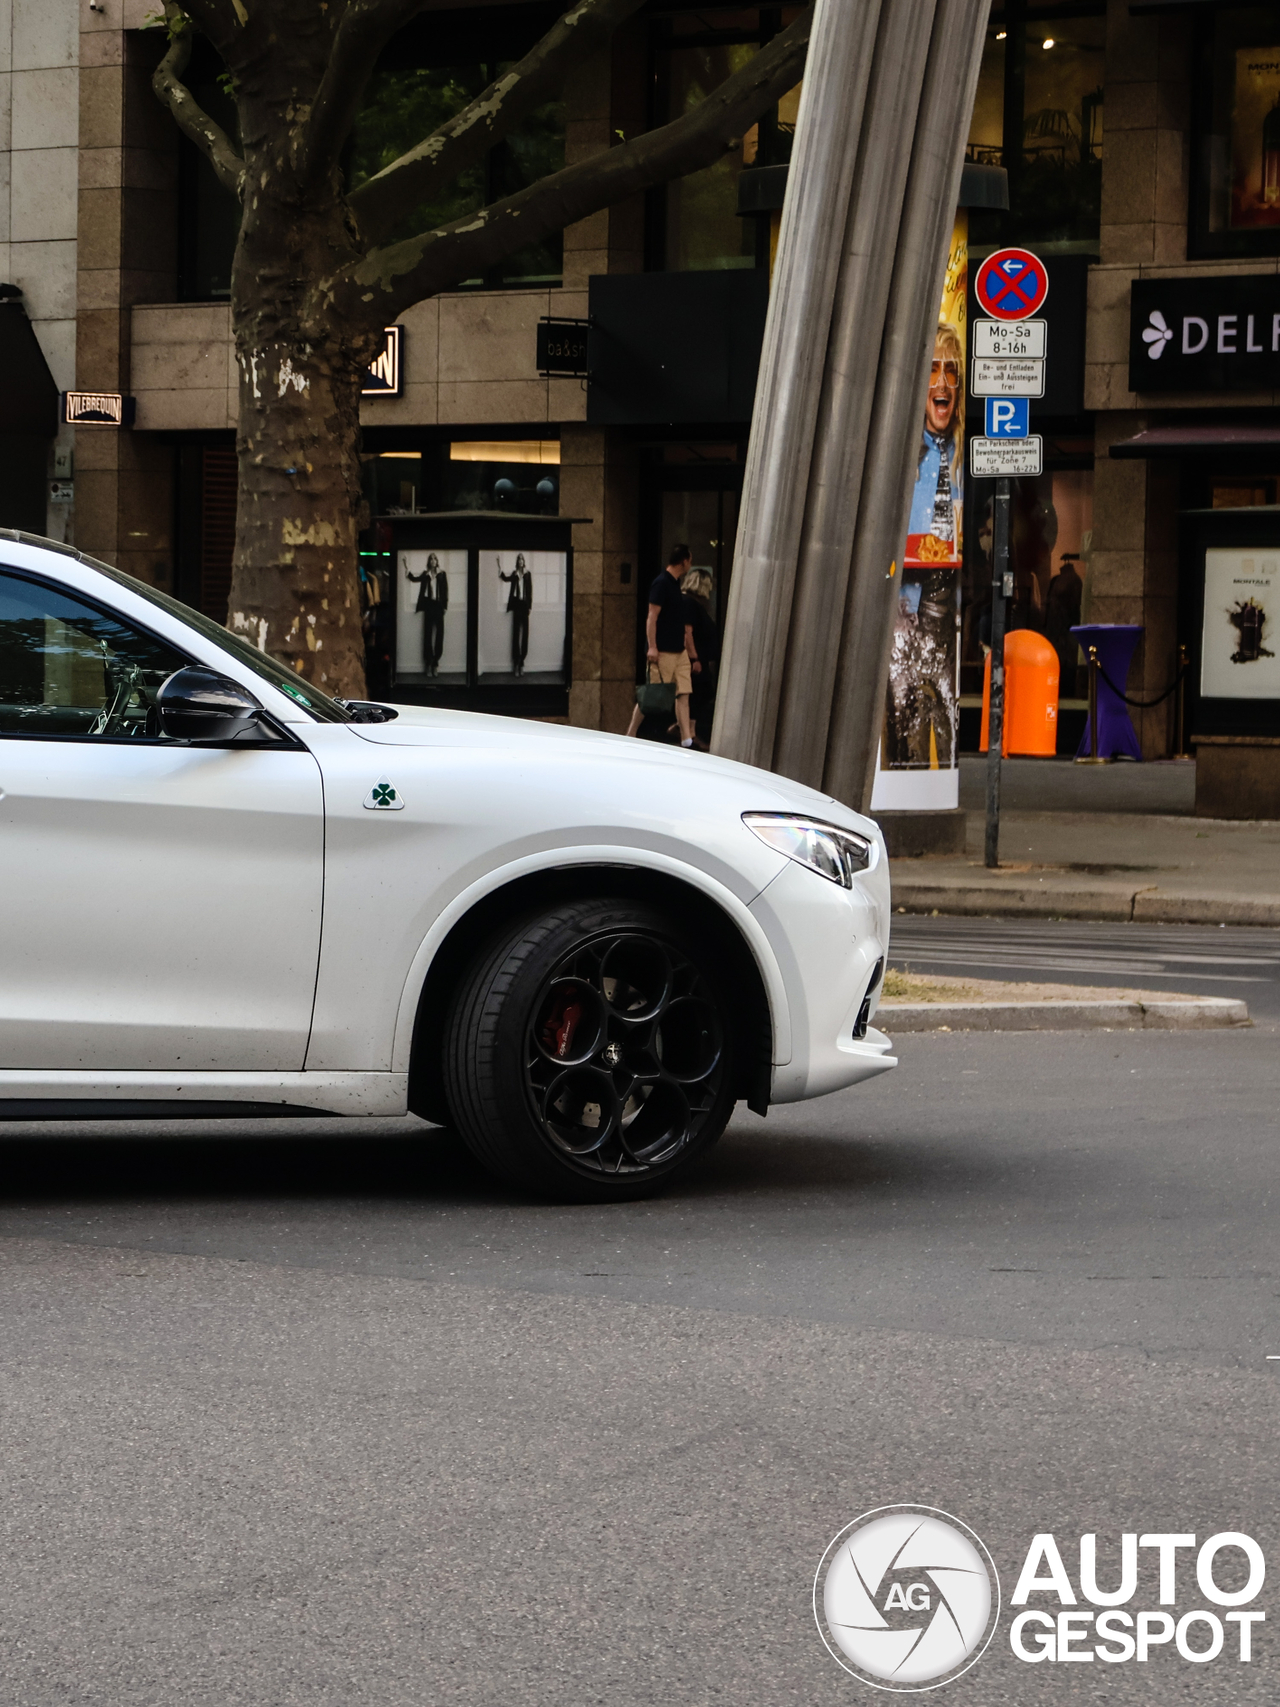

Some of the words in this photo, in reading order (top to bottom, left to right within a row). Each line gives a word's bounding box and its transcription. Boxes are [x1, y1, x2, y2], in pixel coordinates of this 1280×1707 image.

[989, 325, 1031, 338] Mo-Sa
[547, 338, 586, 358] ba&sh
[993, 342, 1027, 353] 8-16h
[982, 363, 993, 371] Be-
[996, 363, 1007, 371] und
[1009, 363, 1034, 371] Entladen
[1006, 373, 1038, 382] Aussteigen
[69, 395, 120, 421] VILEBREQUIN
[992, 400, 1016, 433] P
[989, 439, 1020, 447] Parkschein
[975, 466, 1000, 474] Mo-Sa
